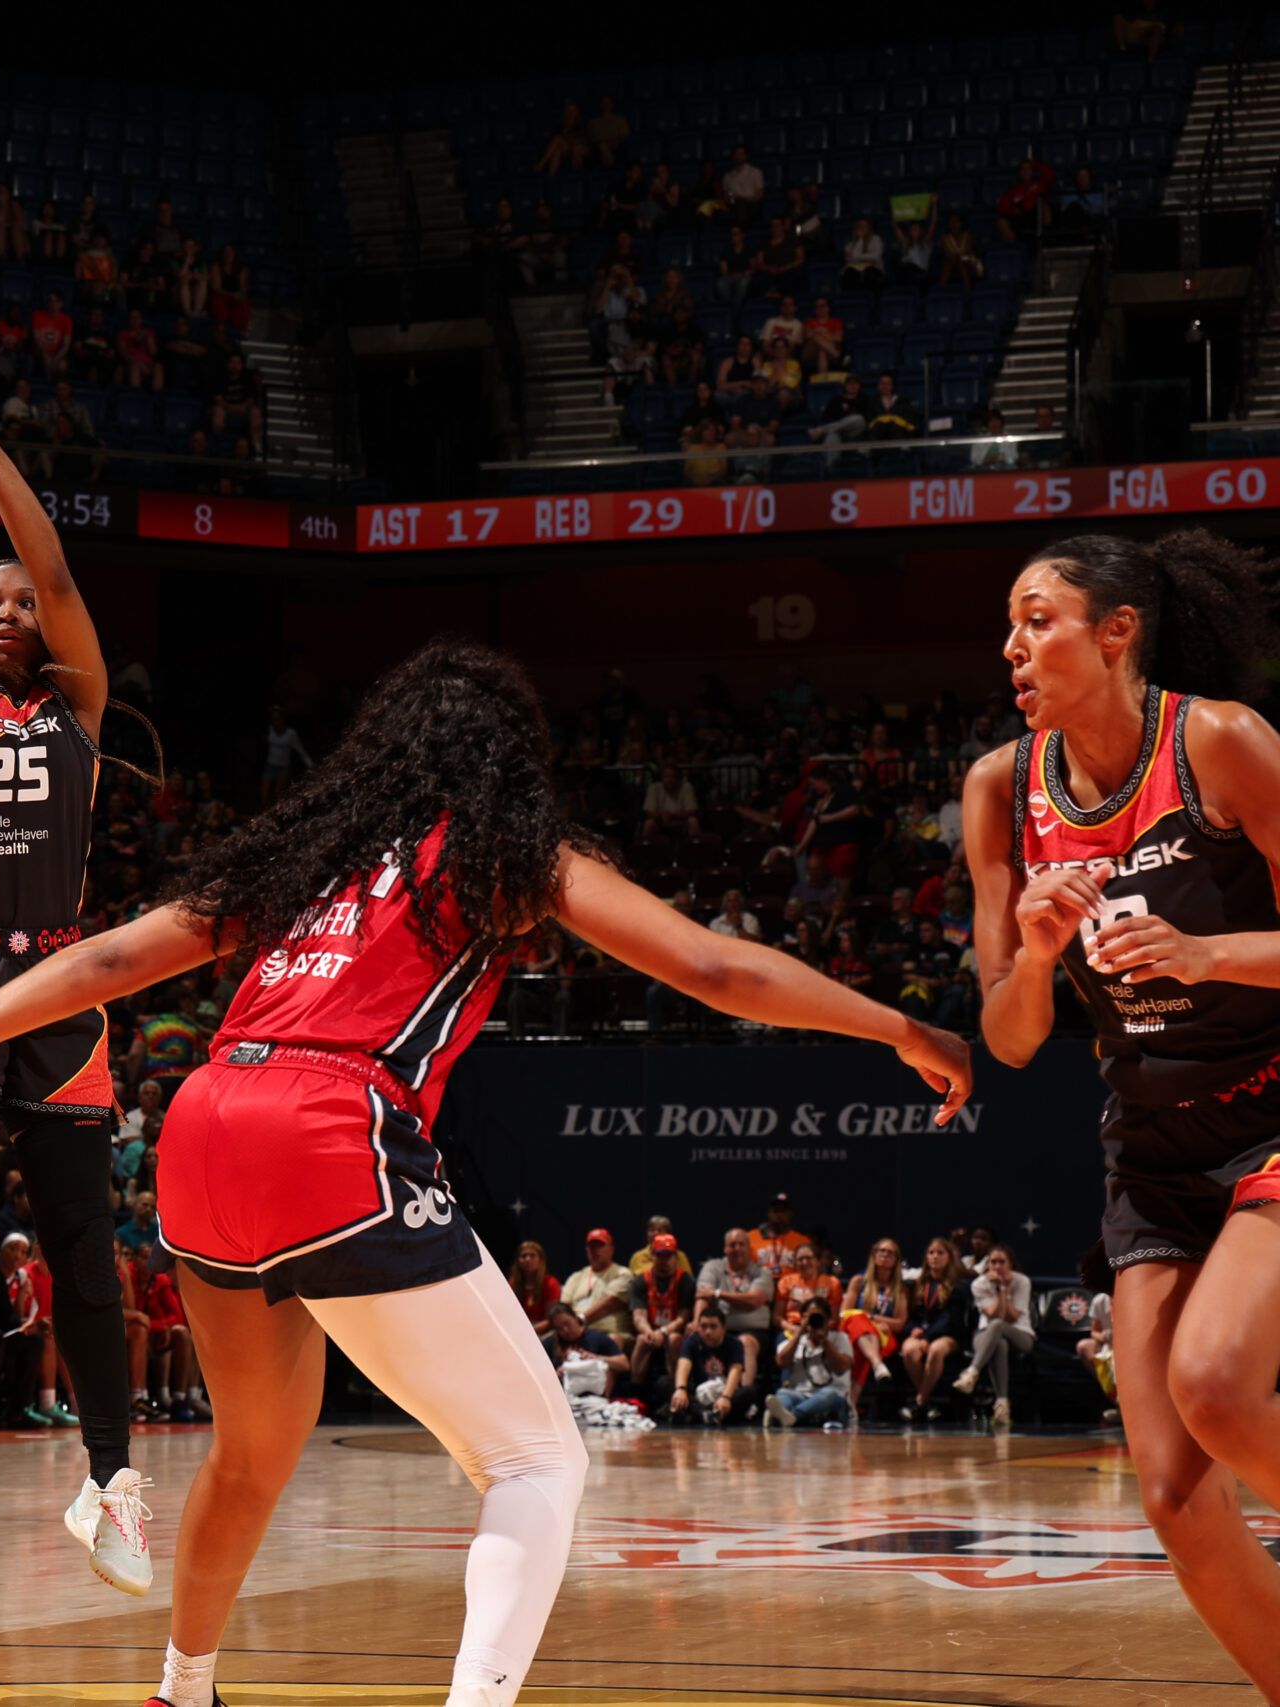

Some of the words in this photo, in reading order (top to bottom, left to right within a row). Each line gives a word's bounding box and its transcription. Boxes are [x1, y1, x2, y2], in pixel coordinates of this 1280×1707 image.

[193, 503, 214, 536] 8
[368, 507, 422, 547] AST
[444, 506, 500, 542] 17
[534, 497, 591, 539] REB
[627, 497, 685, 534] 29
[720, 487, 776, 535] T/O
[829, 487, 859, 524] 8
[908, 476, 975, 520] FGM
[1013, 477, 1072, 515] 25
[1108, 467, 1169, 511] FGA
[1204, 466, 1267, 506] 60
[299, 514, 339, 541] 4th
[747, 592, 816, 640] 19
[1024, 837, 1196, 882] KSUSK
[286, 951, 354, 980] AT&T
[1102, 983, 1136, 999] Yale
[1113, 997, 1194, 1016] NewHaven
[559, 1103, 646, 1137] LUX
[654, 1103, 779, 1138] BOND
[790, 1102, 827, 1137] &
[689, 1148, 762, 1163] JEWELERS
[766, 1148, 810, 1161] SINCE
